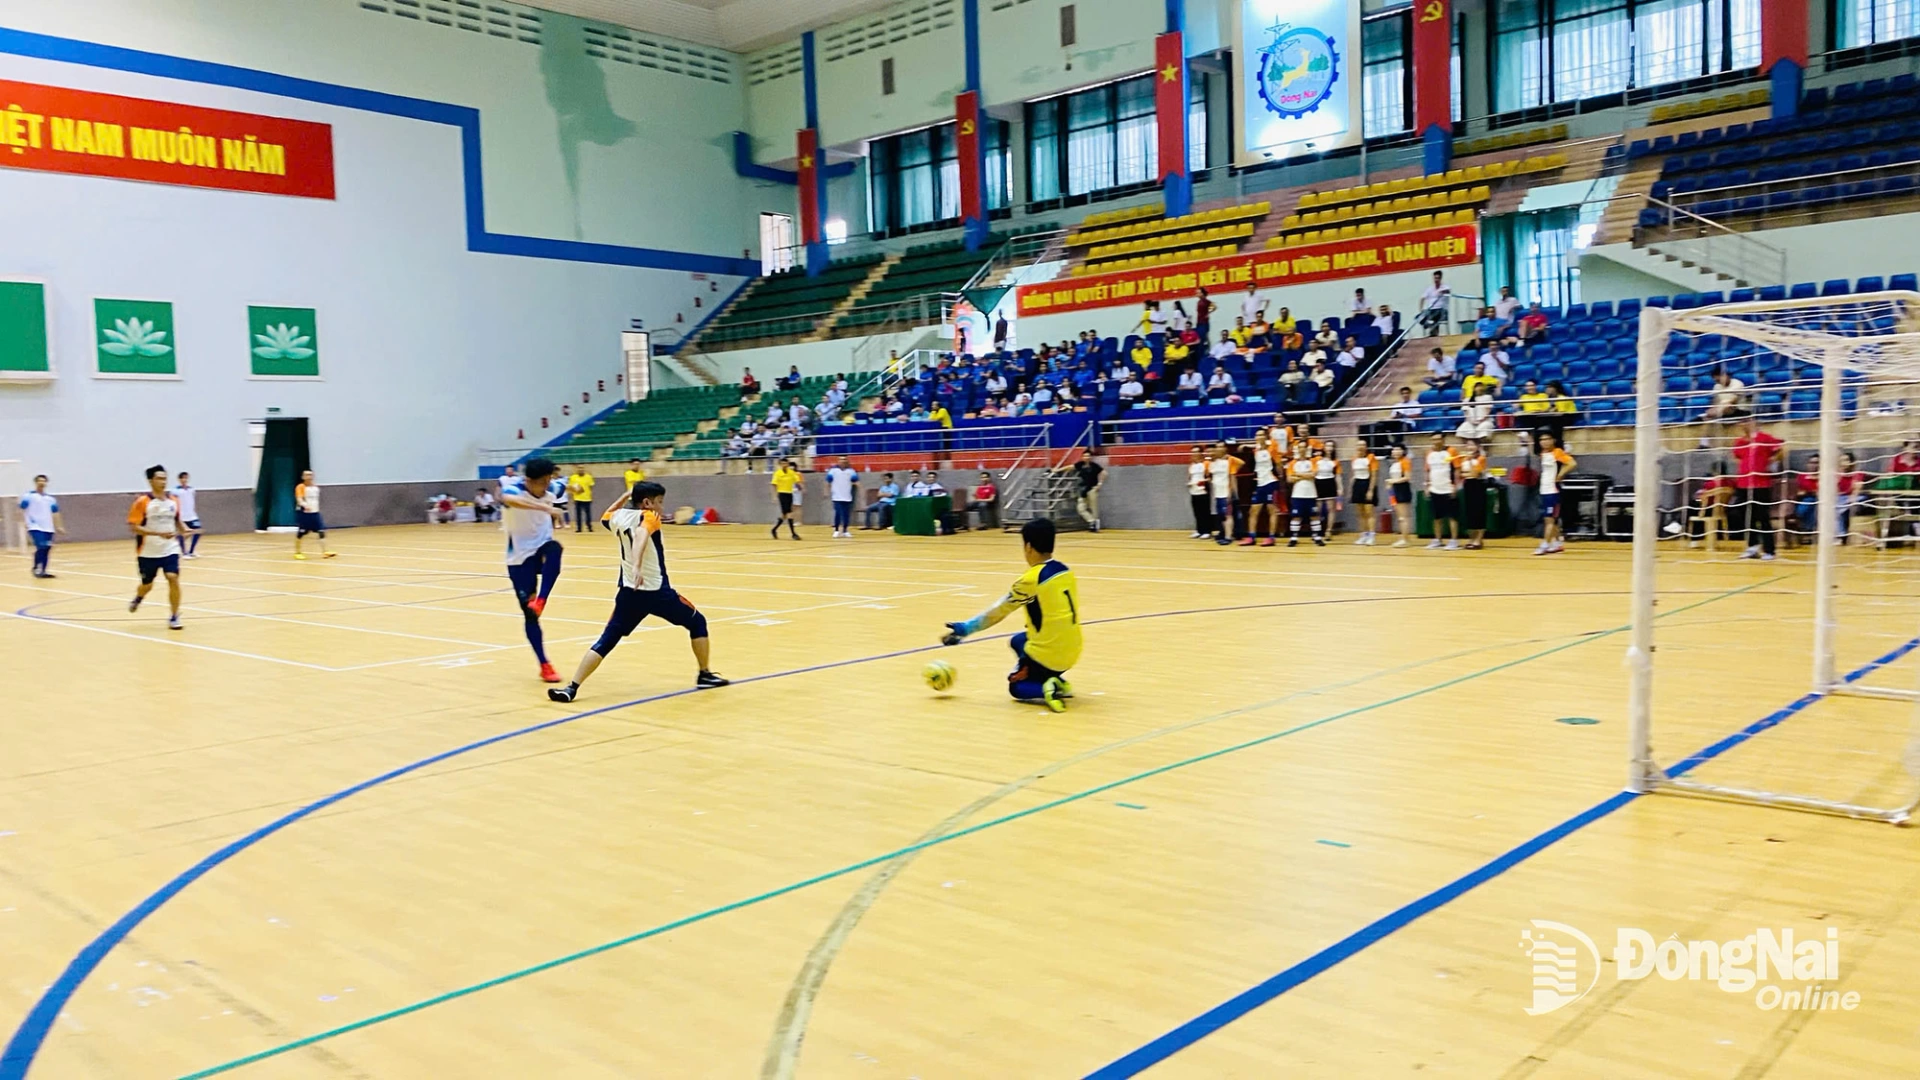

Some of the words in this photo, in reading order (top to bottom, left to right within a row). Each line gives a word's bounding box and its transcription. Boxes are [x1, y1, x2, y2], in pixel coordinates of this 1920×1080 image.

[50, 116, 125, 158] NAM
[130, 126, 218, 169] MUÔN
[222, 135, 286, 176] NĂM
[1111, 279, 1136, 298] TÂM
[1137, 276, 1161, 295] XÂY
[1228, 259, 1253, 283] THỂ
[1255, 260, 1290, 279] THAO
[1384, 241, 1425, 263] TOÀN
[1428, 236, 1466, 260] DIỆN
[597, 380, 605, 392] E
[562, 405, 570, 416] C
[517, 429, 524, 439] A
[616, 527, 634, 561] 11
[1063, 589, 1077, 624] 1
